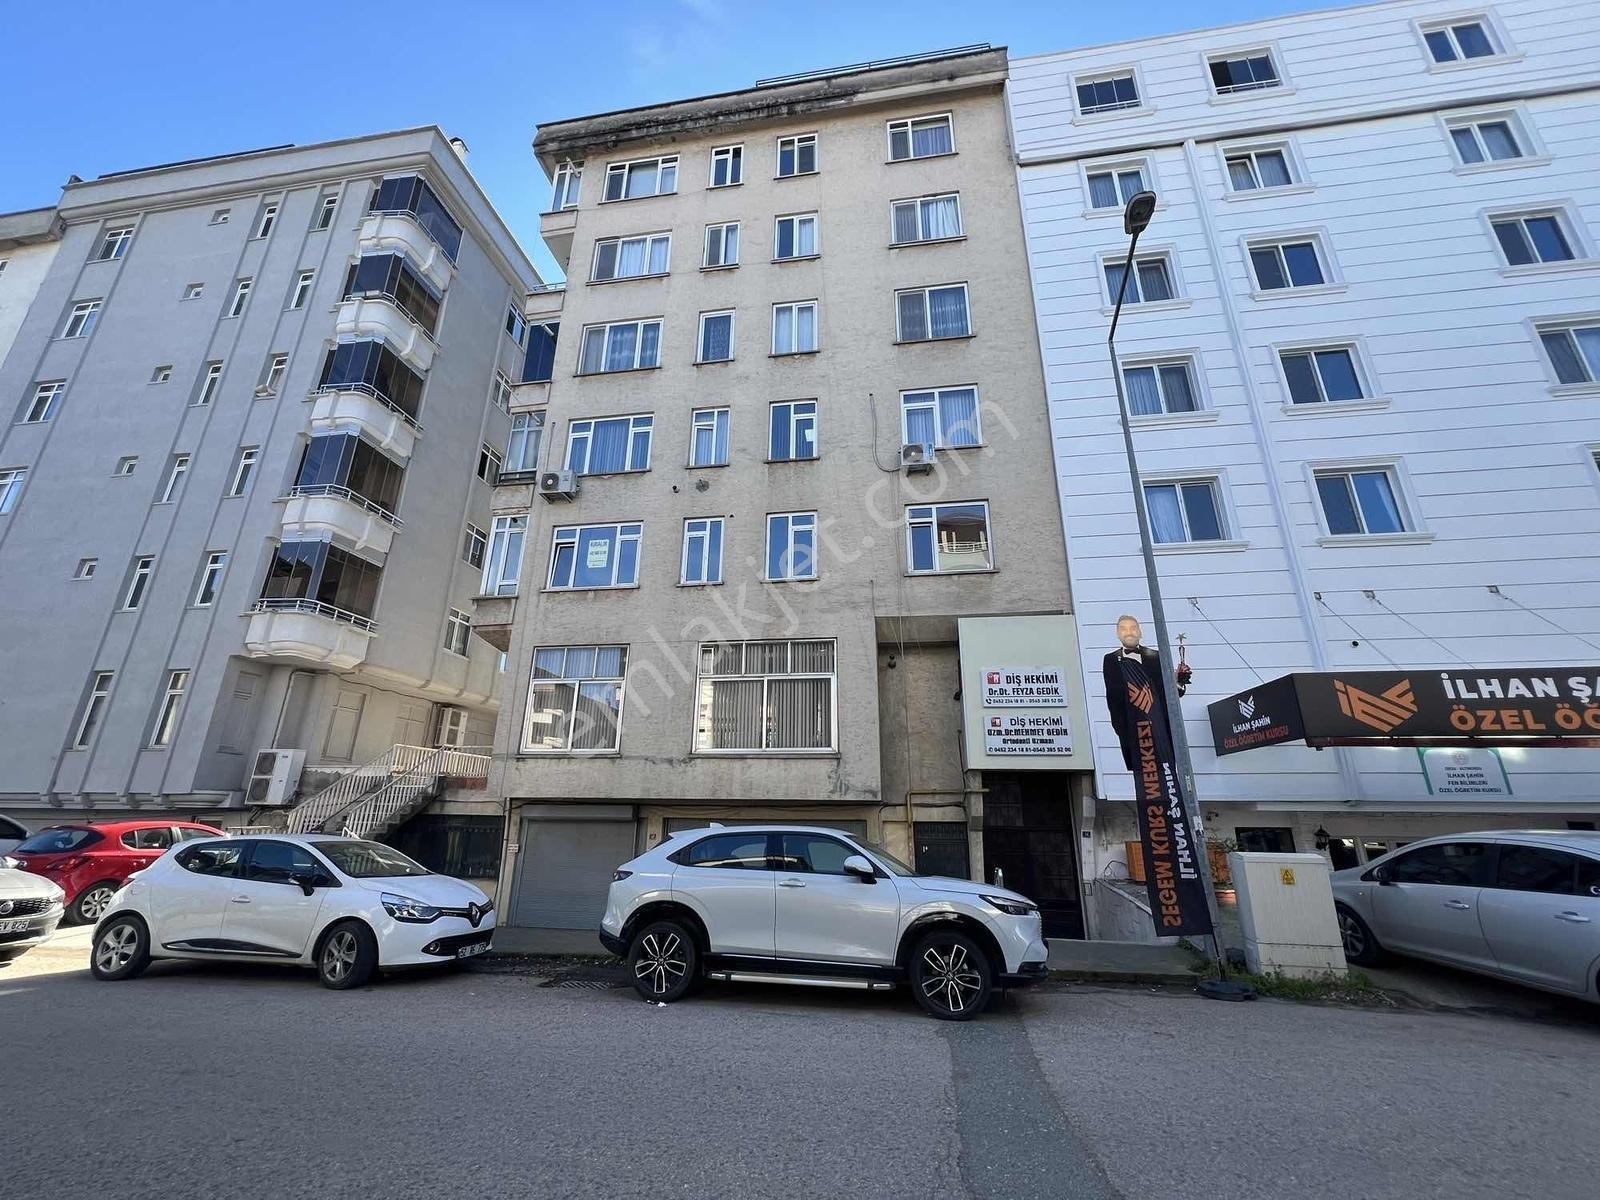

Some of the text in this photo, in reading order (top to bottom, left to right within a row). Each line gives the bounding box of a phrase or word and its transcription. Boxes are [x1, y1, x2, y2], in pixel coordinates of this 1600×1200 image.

[1006, 672, 1059, 686] DİŞ HEKİMİ
[1440, 672, 1560, 699] İLHAN
[1012, 687, 1035, 696] FEYZA
[1036, 685, 1060, 695] GEDİK
[1010, 716, 1063, 728] DİŞ HEKİMİ
[1232, 714, 1271, 734] İLHAN ŞAHİN
[1449, 704, 1546, 731] ÖZEL
